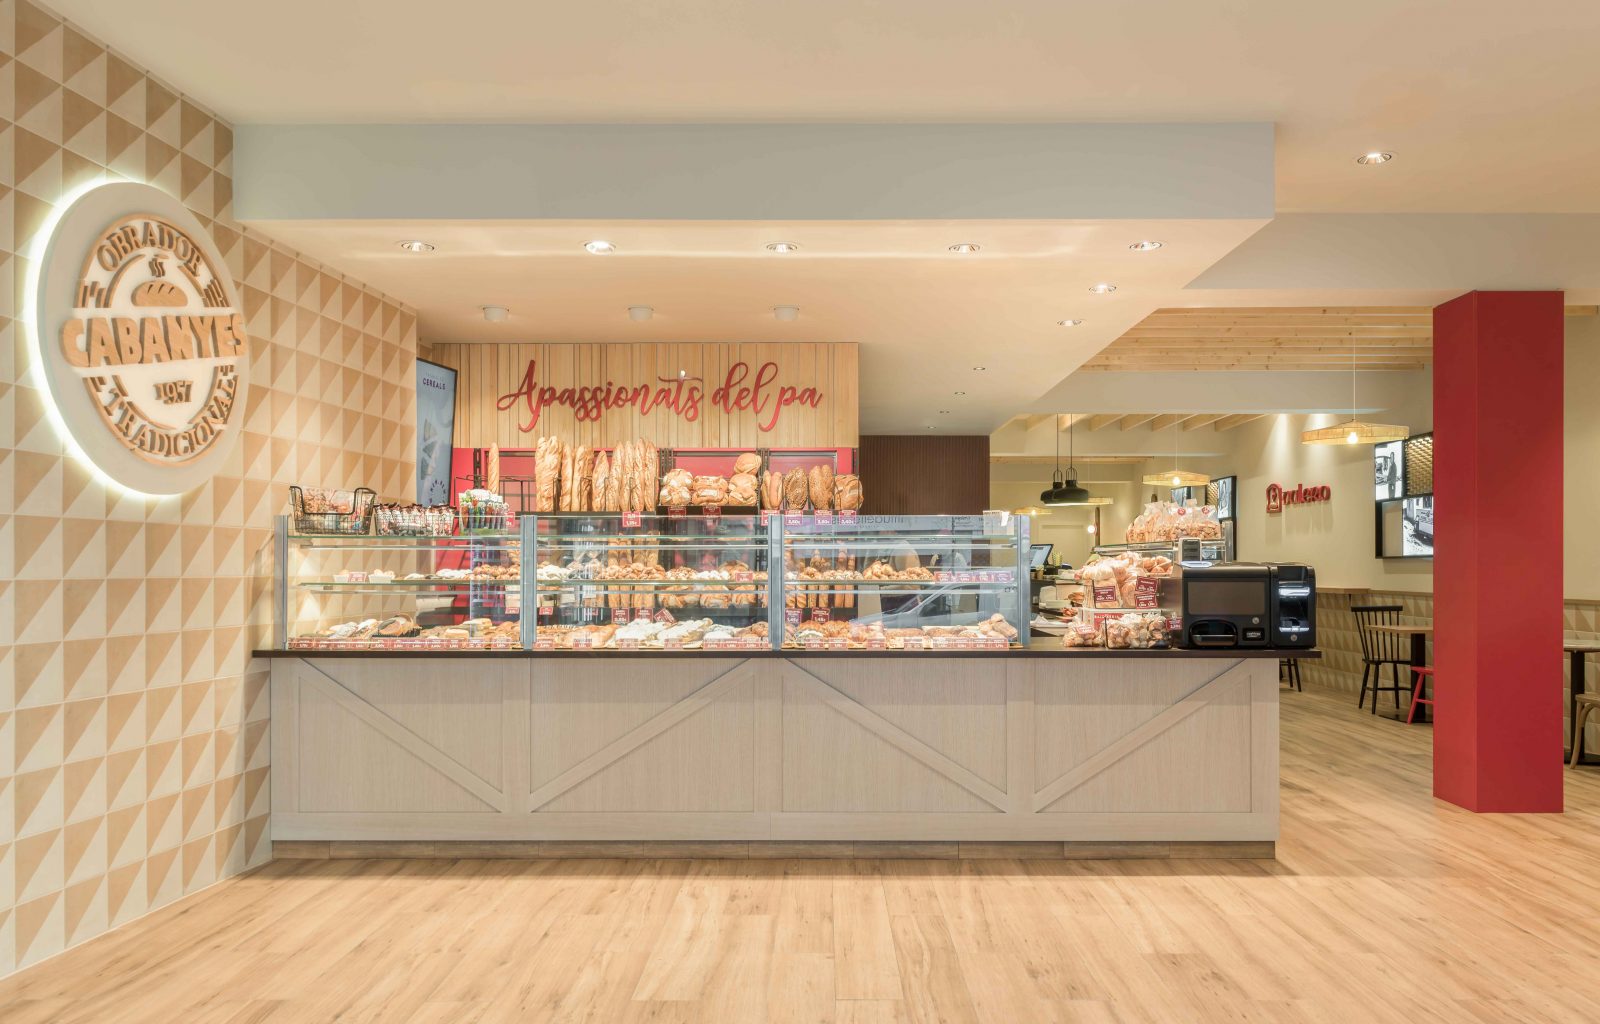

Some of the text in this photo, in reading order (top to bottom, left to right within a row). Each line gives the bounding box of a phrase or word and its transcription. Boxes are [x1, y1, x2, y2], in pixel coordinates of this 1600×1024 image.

[96, 221, 204, 277] OBRADOR
[60, 314, 248, 368] CABANYES
[103, 374, 240, 457] TRADICIONAL
[153, 379, 193, 404] 1957
[496, 359, 823, 433] Apassionats del pa
